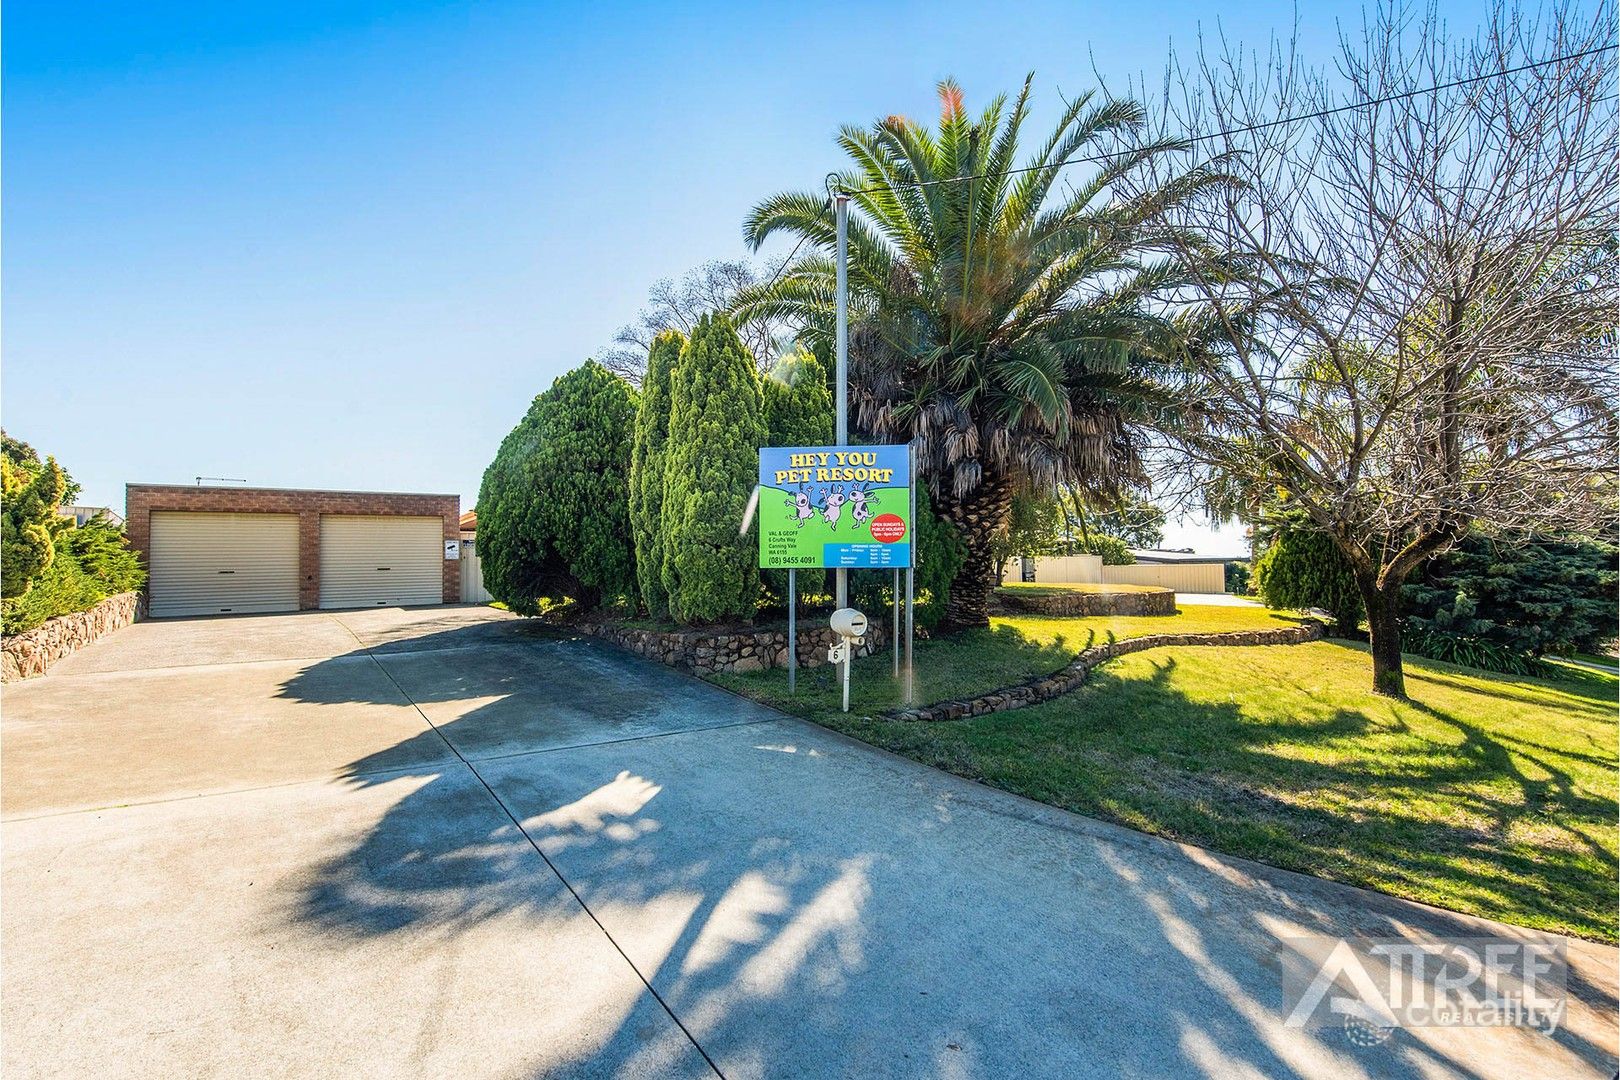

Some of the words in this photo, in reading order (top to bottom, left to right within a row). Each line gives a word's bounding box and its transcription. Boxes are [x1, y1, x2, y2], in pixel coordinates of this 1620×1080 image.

[790, 453, 830, 468] HEY
[834, 452, 877, 467] YOU
[774, 469, 812, 484] PET
[816, 468, 894, 483] RESORT
[769, 557, 781, 565] (08)
[834, 650, 838, 659] 6
